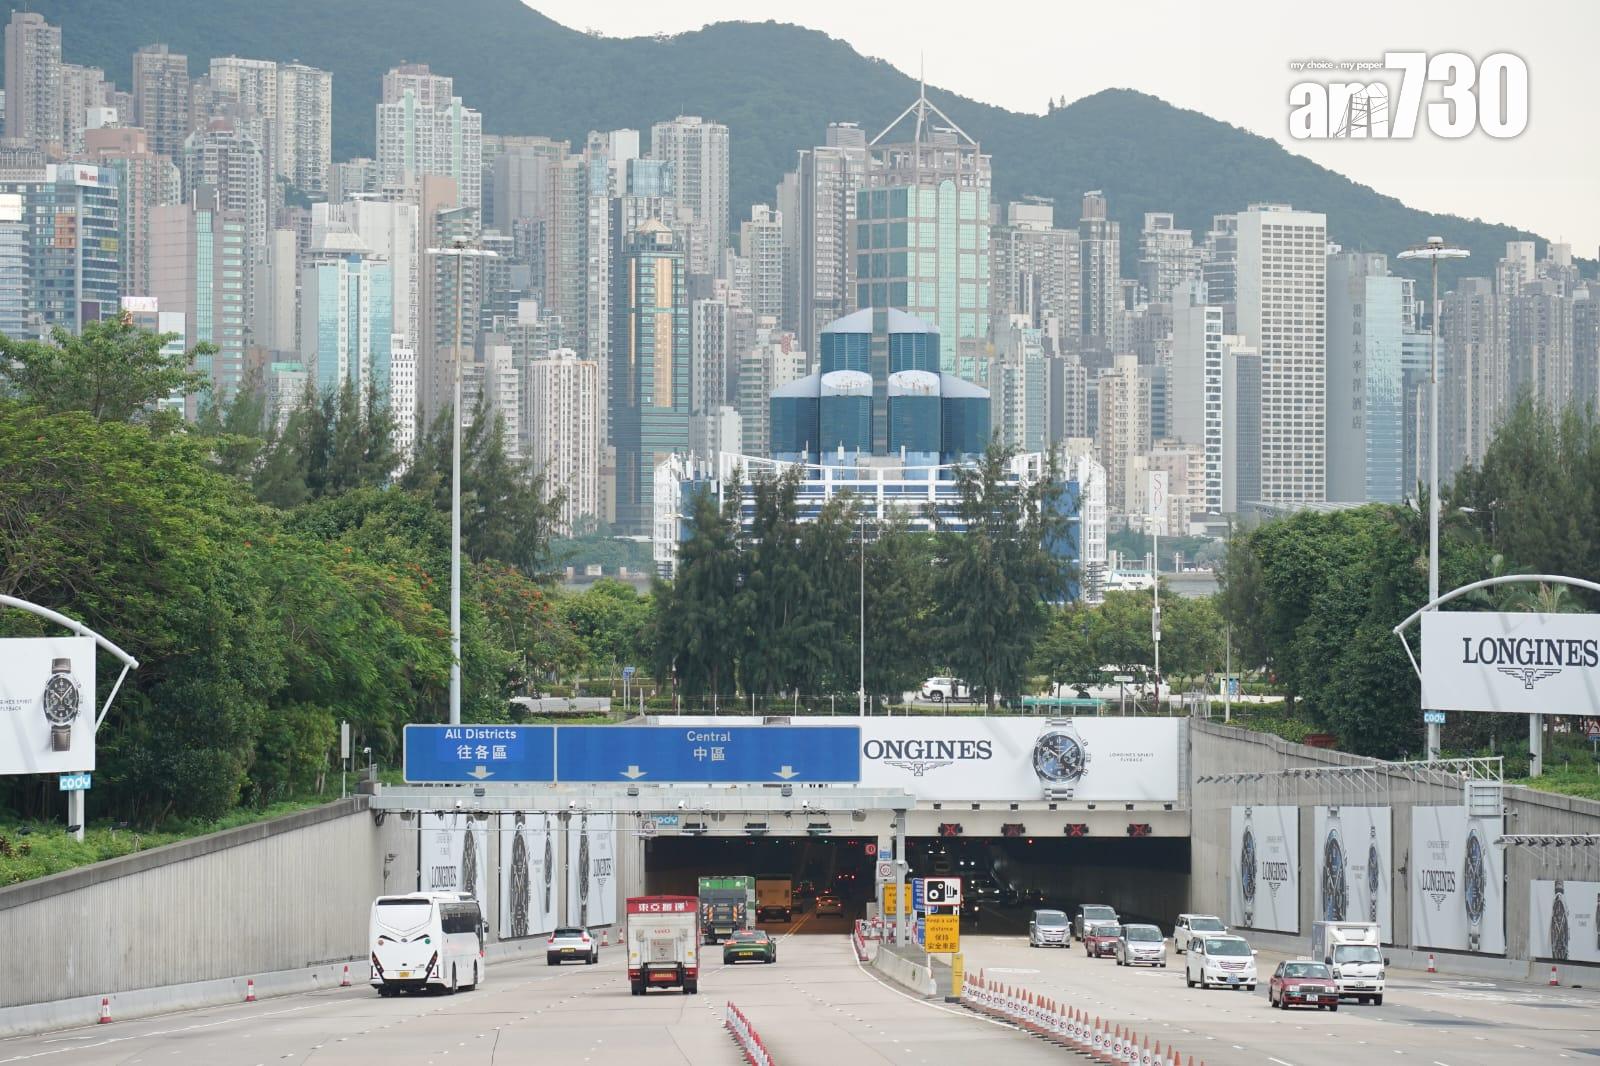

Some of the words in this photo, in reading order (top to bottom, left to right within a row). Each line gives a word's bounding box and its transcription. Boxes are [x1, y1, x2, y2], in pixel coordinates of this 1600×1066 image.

[1462, 637, 1599, 668] LONGINES
[444, 728, 461, 740] All
[465, 728, 517, 740] Districts
[686, 730, 732, 742] Central
[456, 744, 508, 760] 往各區
[693, 746, 726, 762] 中區
[863, 740, 993, 760] ONGINES
[60, 775, 91, 790] cody
[431, 865, 457, 888] LONGINES
[1262, 862, 1288, 881] LONGINES
[1422, 869, 1456, 892] LONGINES
